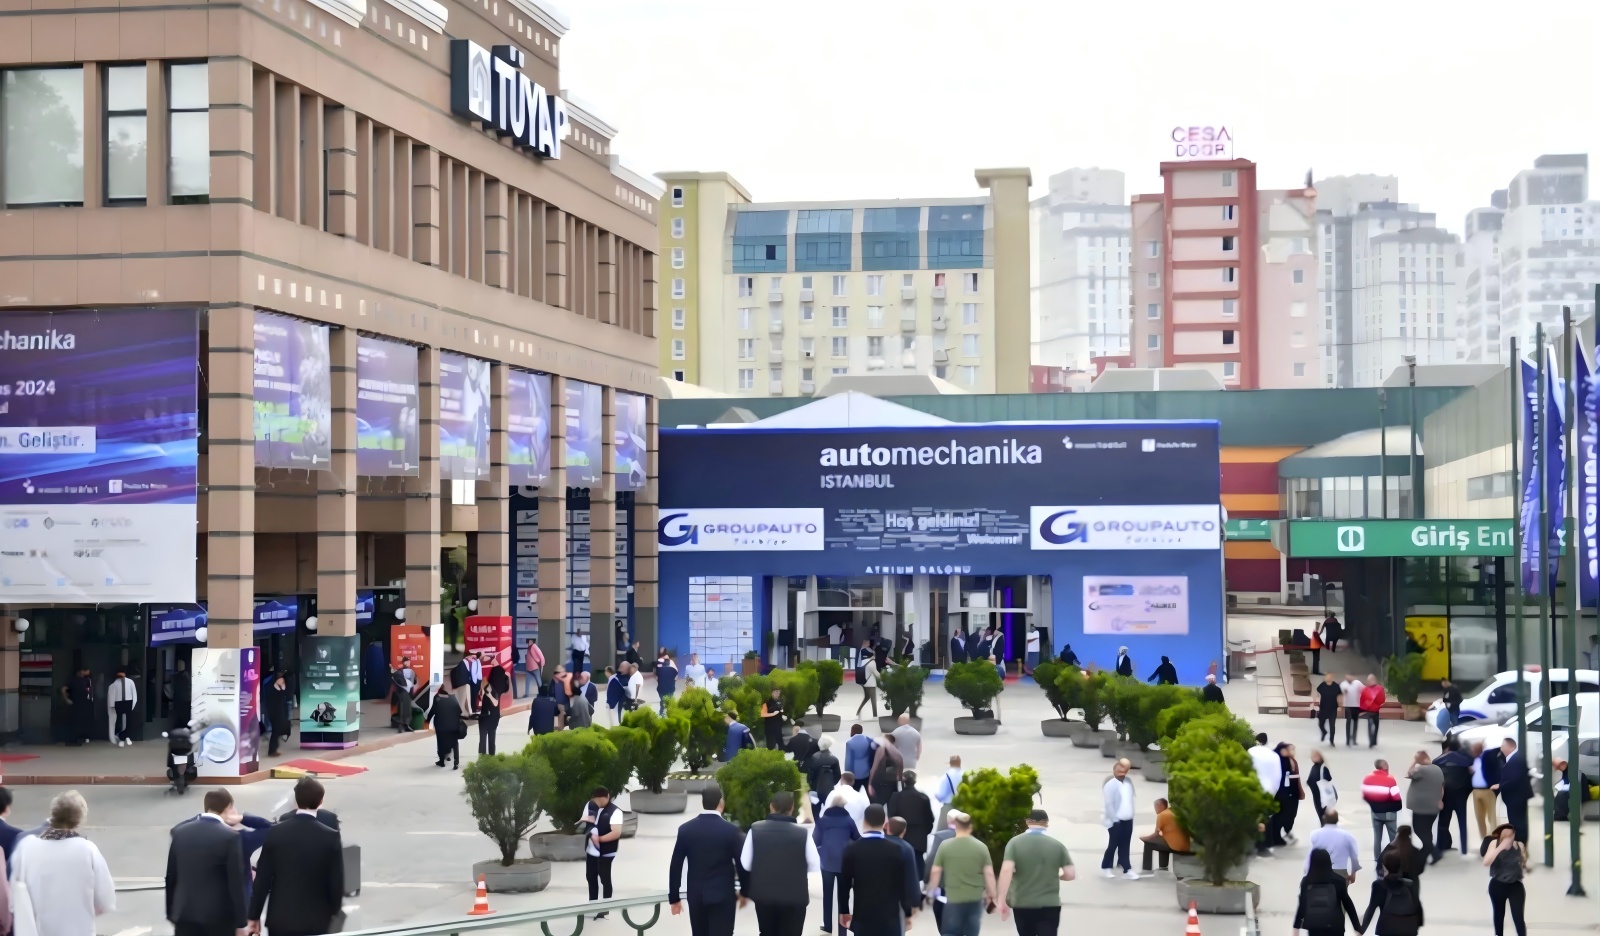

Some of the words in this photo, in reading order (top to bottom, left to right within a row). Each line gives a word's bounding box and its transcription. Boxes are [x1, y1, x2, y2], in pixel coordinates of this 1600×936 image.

[494, 45, 571, 160] TÜYAP
[1171, 126, 1232, 143] CESA
[15, 380, 56, 396] 2024
[19, 432, 84, 451] Geliştir.
[820, 438, 1043, 467] automechanika
[820, 474, 895, 489] ISTANBUL
[703, 523, 818, 534] GROUPAUTO
[1093, 520, 1215, 532] GROUPAUTO
[1411, 525, 1470, 551] Giriş
